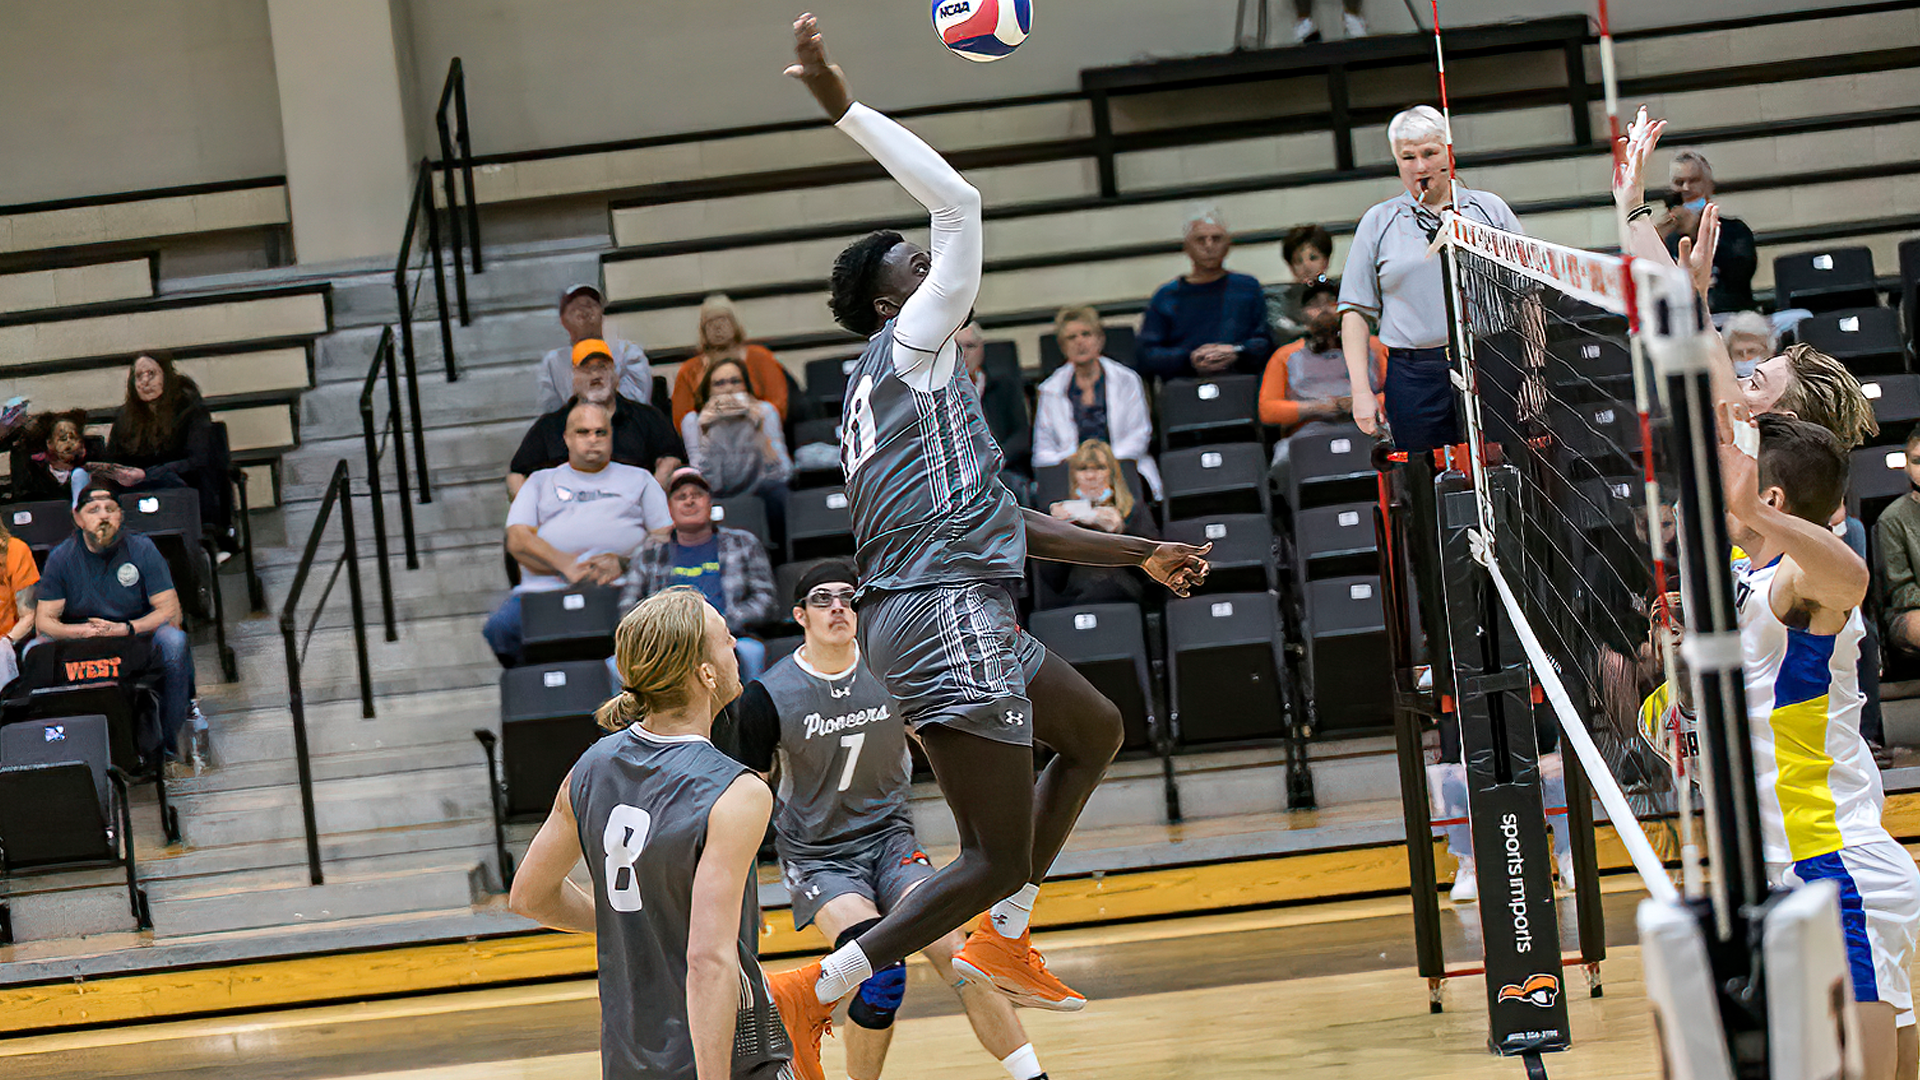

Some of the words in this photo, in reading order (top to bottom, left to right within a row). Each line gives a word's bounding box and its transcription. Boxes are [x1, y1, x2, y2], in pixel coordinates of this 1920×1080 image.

[940, 1, 970, 19] NCAA
[65, 657, 121, 682] WEST
[803, 704, 891, 740] Pioneers
[838, 732, 865, 792] 7
[603, 803, 651, 912] 8
[1500, 813, 1525, 876] sports
[1508, 877, 1532, 953] imports
